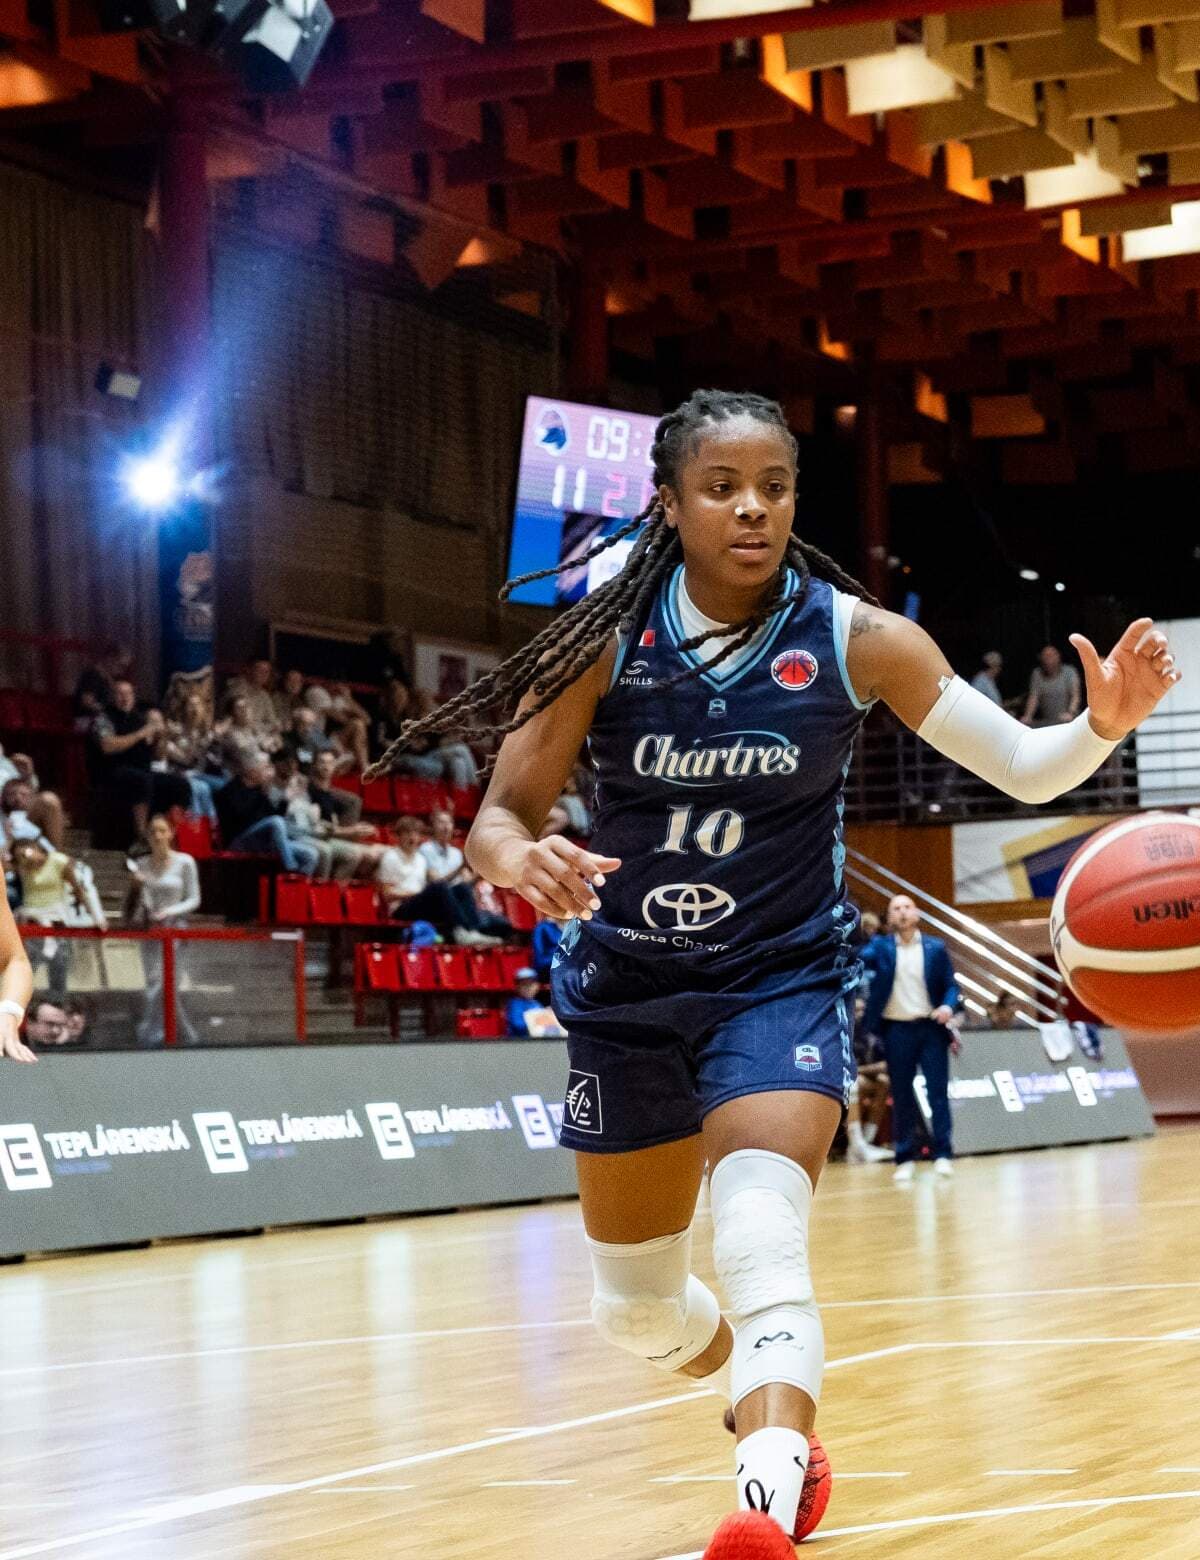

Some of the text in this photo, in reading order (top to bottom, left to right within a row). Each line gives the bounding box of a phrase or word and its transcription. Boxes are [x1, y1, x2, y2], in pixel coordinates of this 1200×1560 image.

[619, 677, 653, 686] SKILLS
[633, 734, 801, 778] Chartres
[654, 803, 745, 857] 10
